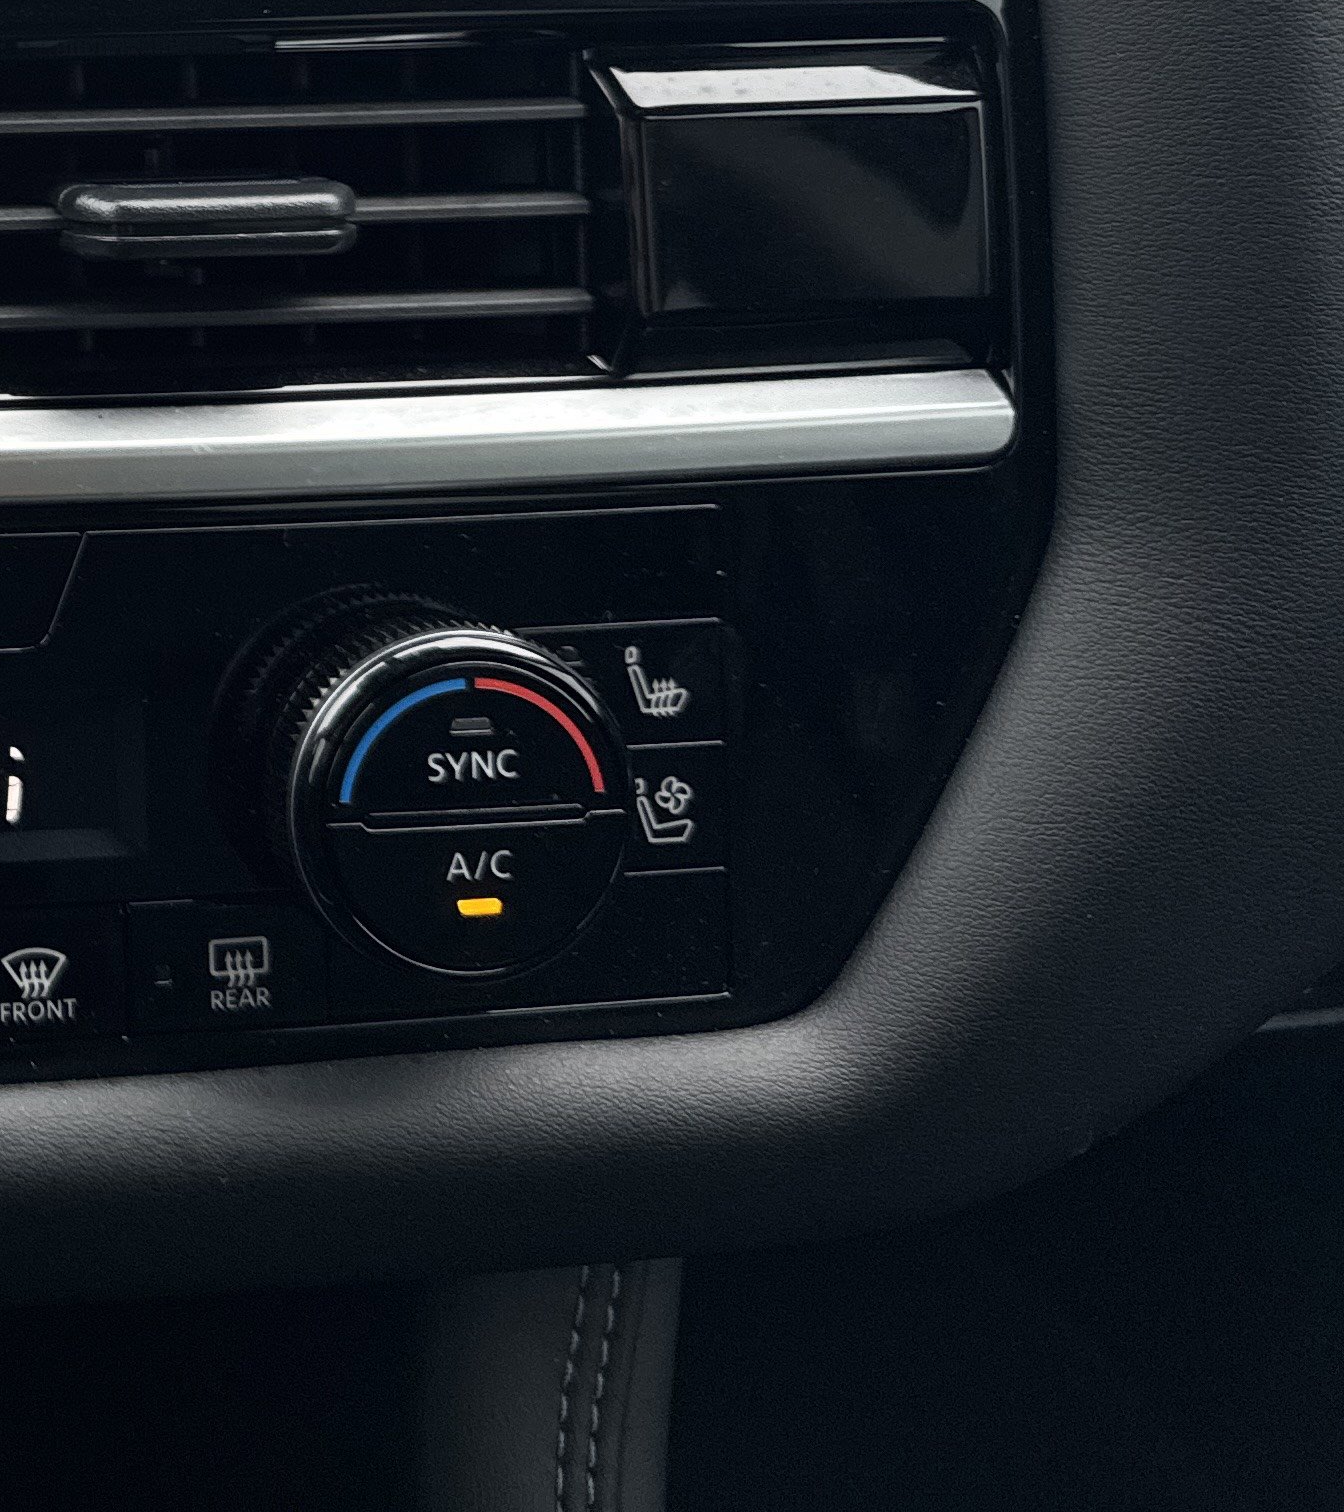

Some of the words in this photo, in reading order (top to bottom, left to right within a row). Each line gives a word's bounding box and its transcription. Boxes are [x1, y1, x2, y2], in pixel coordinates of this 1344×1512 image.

[427, 750, 518, 782] SYNC
[447, 851, 512, 881] A/C
[0, 998, 78, 1021] FRONT
[210, 988, 271, 1010] REAR
